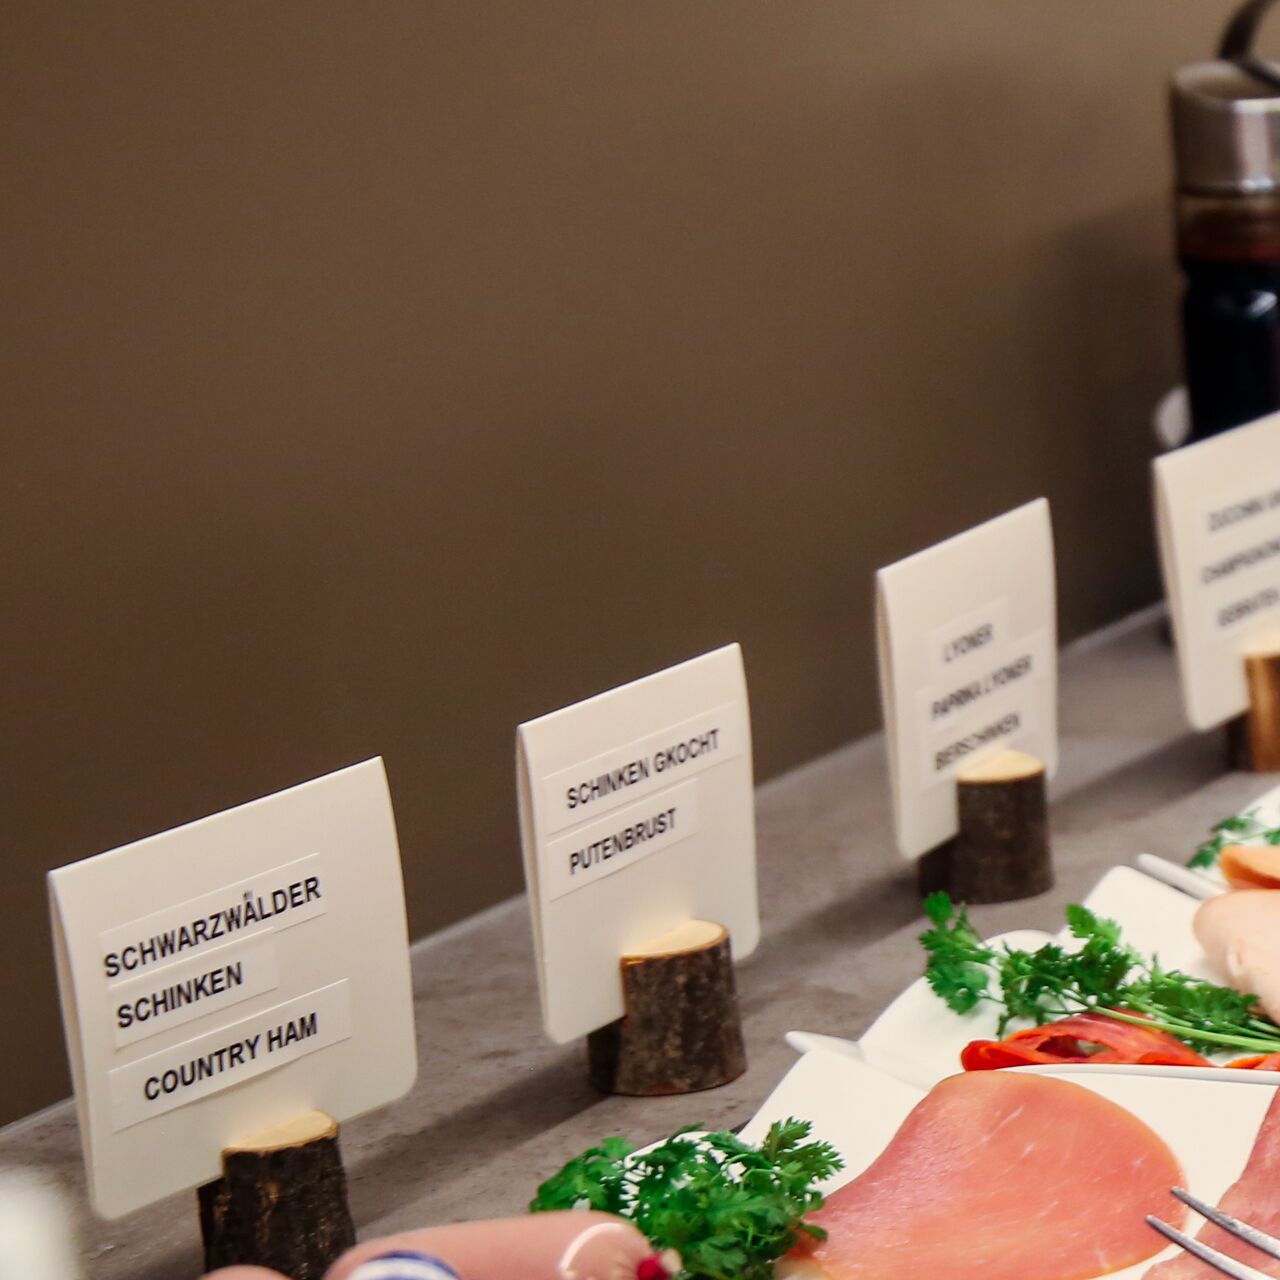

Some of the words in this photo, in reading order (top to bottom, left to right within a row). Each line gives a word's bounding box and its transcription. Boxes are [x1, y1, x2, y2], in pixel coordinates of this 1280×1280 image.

[945, 623, 992, 662] LYONER
[566, 756, 650, 810] SCHINKEN
[653, 727, 720, 774] GKOCHT
[569, 807, 677, 876] PUTENBRUST
[103, 875, 322, 979] SCHWARZWÄLDER
[116, 961, 244, 1030] SCHINKEN
[143, 1034, 262, 1102] COUNTRY
[266, 1011, 319, 1060] HAM
